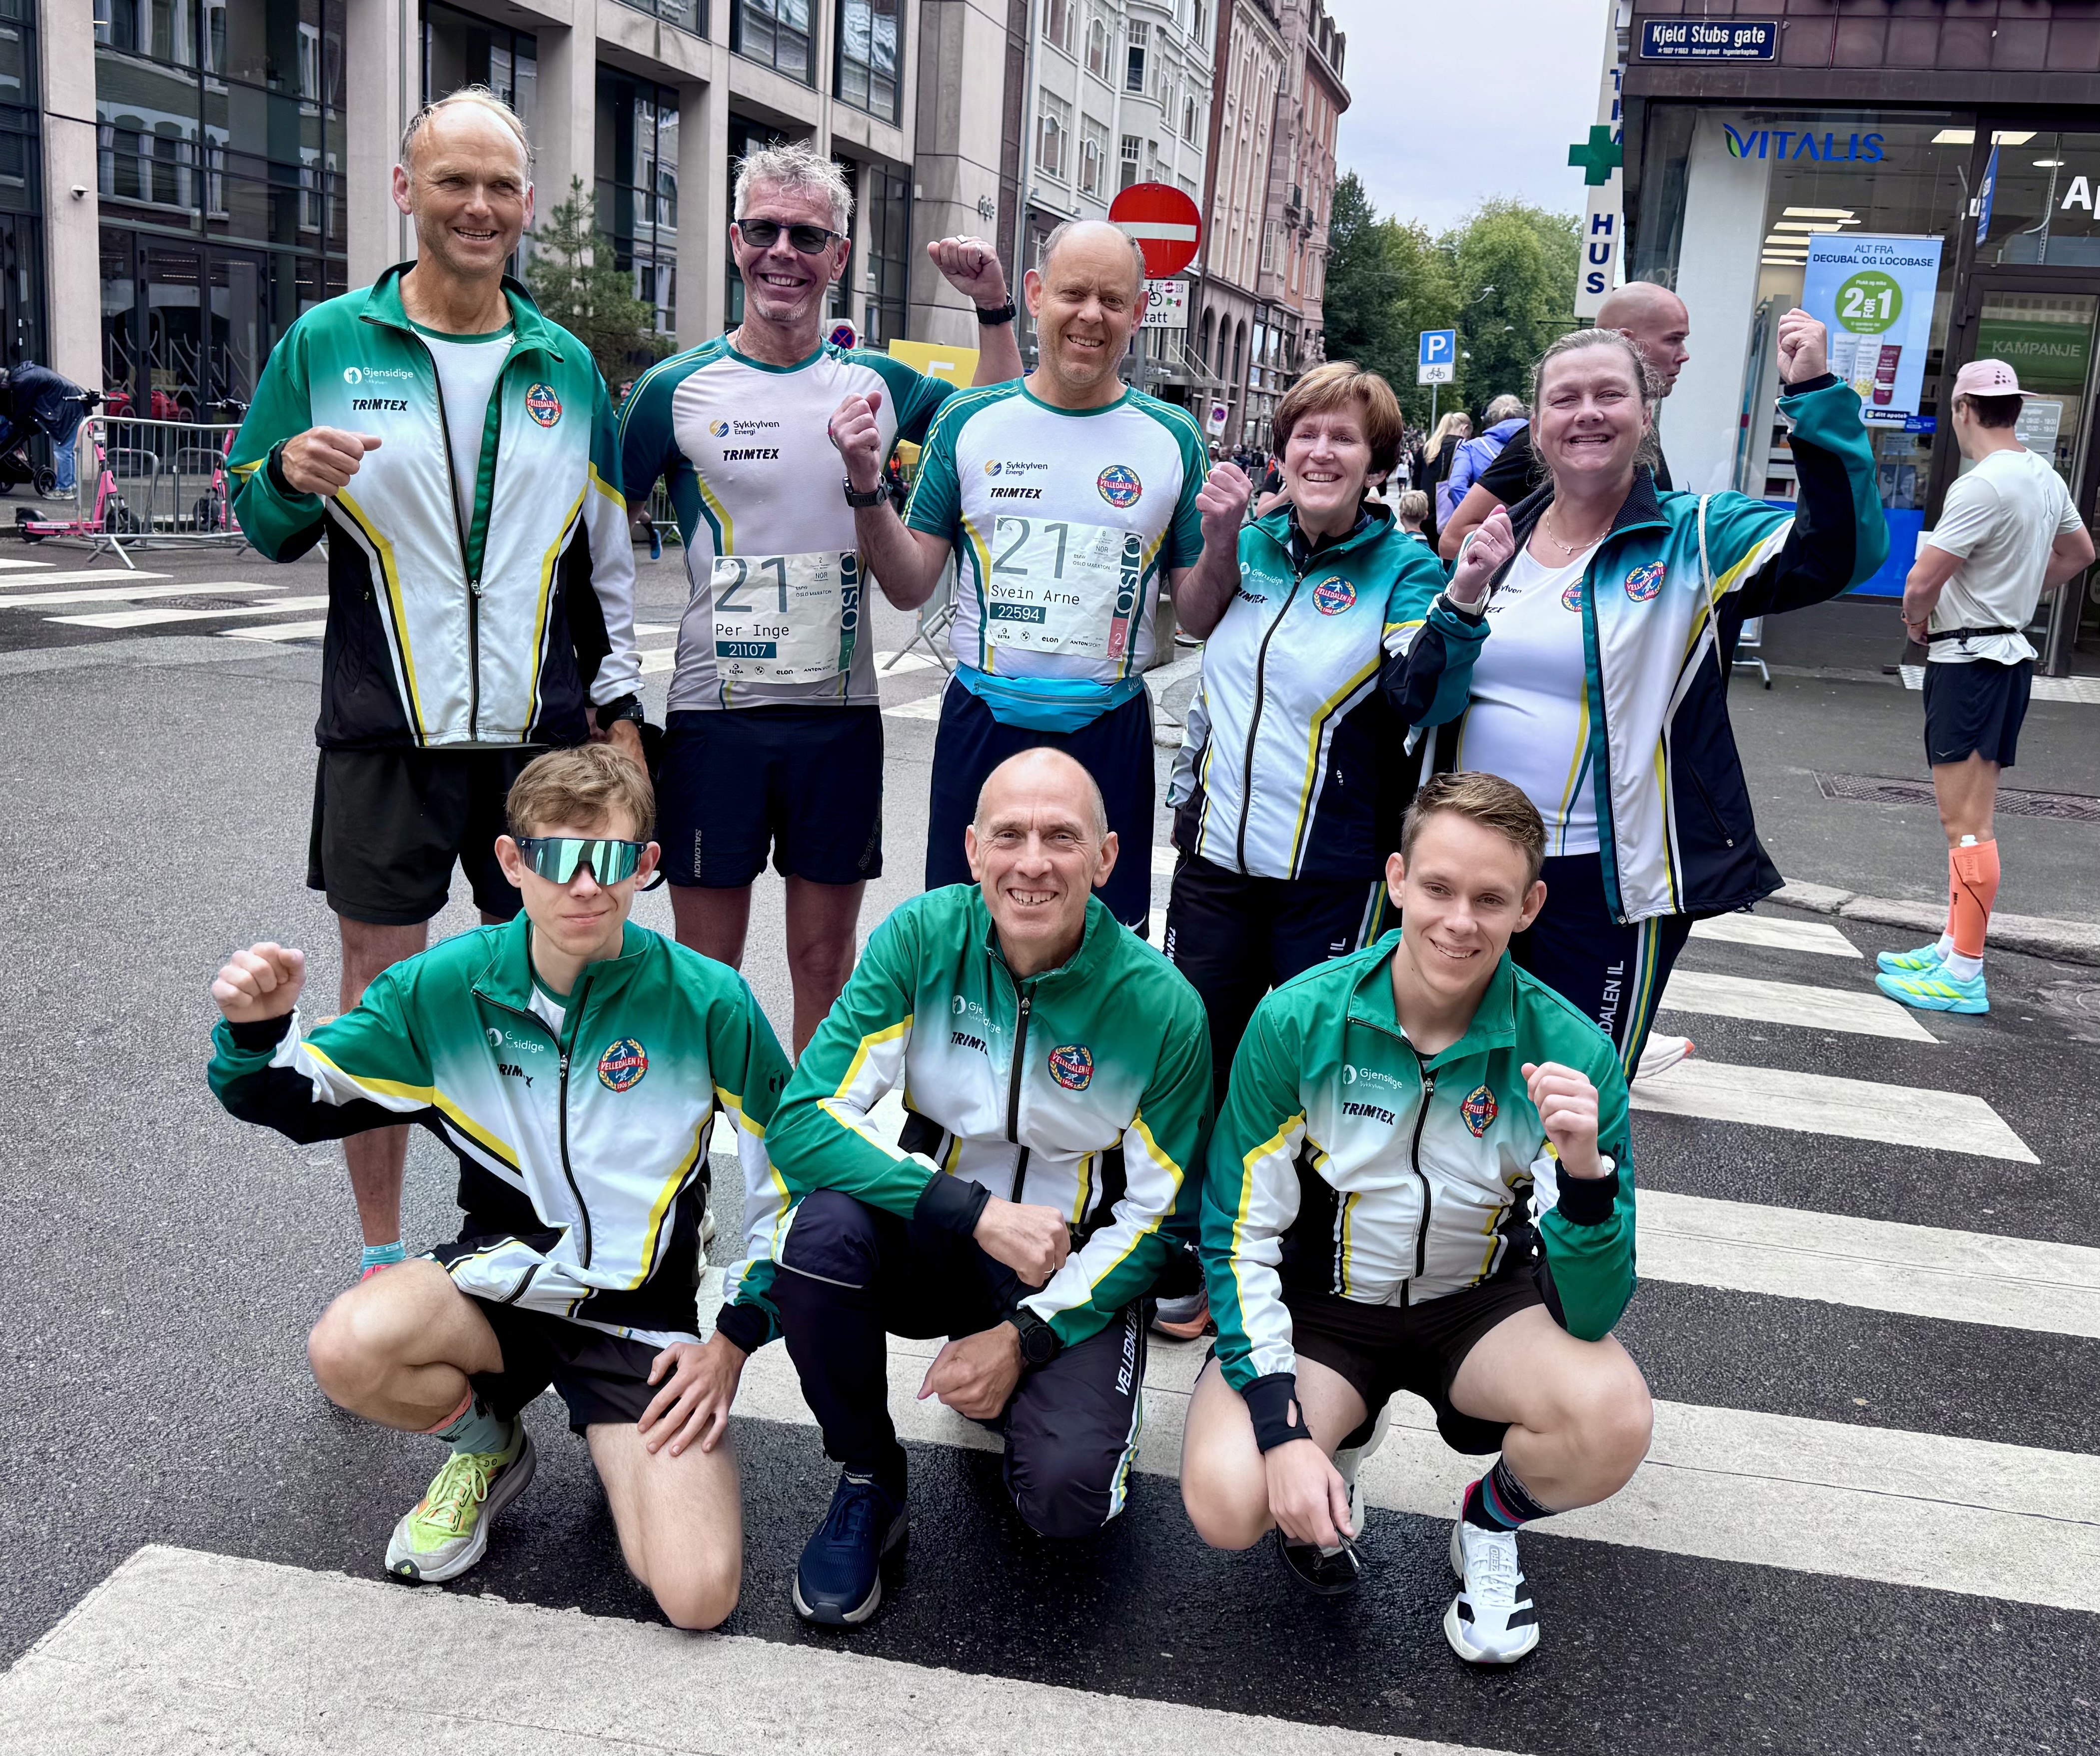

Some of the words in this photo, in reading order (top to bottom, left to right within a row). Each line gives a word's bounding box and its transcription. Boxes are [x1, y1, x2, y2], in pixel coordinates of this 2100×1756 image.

[1653, 25, 1686, 45] Kjeld
[1691, 26, 1729, 43] Stubs
[1734, 27, 1765, 47] gate
[1723, 123, 1885, 163] VITALIS
[1855, 245, 1872, 253] ALT
[1875, 245, 1894, 254] FRA
[1813, 254, 1859, 264] DECUBAL
[1880, 257, 1934, 266] LOCOBASE
[1842, 287, 1864, 317] 2
[1863, 298, 1876, 318] FOR
[1878, 289, 1893, 319] 1
[1145, 311, 1168, 323] tatt
[1428, 335, 1446, 360] P
[1992, 340, 2082, 357] KAMPANJE
[363, 367, 414, 379] Gjensidige
[352, 399, 408, 411] TRIMTEX
[733, 420, 780, 429] Sykkylven
[723, 449, 780, 461] TRIMTEX
[1007, 462, 1048, 470] Sykkylven
[1100, 479, 1132, 490] VELLEDALEN
[991, 488, 1042, 499] TRIMTEX
[993, 517, 1068, 579] 21
[715, 557, 788, 613] 21
[1251, 569, 1283, 586] Gjensidige
[991, 585, 1034, 600] Svein
[1044, 590, 1079, 605] Arne
[1316, 587, 1346, 602] VELLEDALEN
[998, 605, 1040, 621] 22594
[716, 624, 742, 636] Per
[753, 625, 789, 639] Inge
[1114, 633, 1121, 645] 2
[729, 644, 767, 656] 21107
[1607, 960, 1624, 975] IL
[1598, 979, 1622, 1036] DALEN
[601, 1057, 636, 1070] VELLEDALEN
[637, 1057, 644, 1066] IL
[1052, 1053, 1085, 1074] VELLEDALEN
[1342, 1102, 1395, 1125] TRIMTEX
[1115, 1305, 1137, 1396] VELLEDALEN
[1490, 1548, 1499, 1571] ZERO
